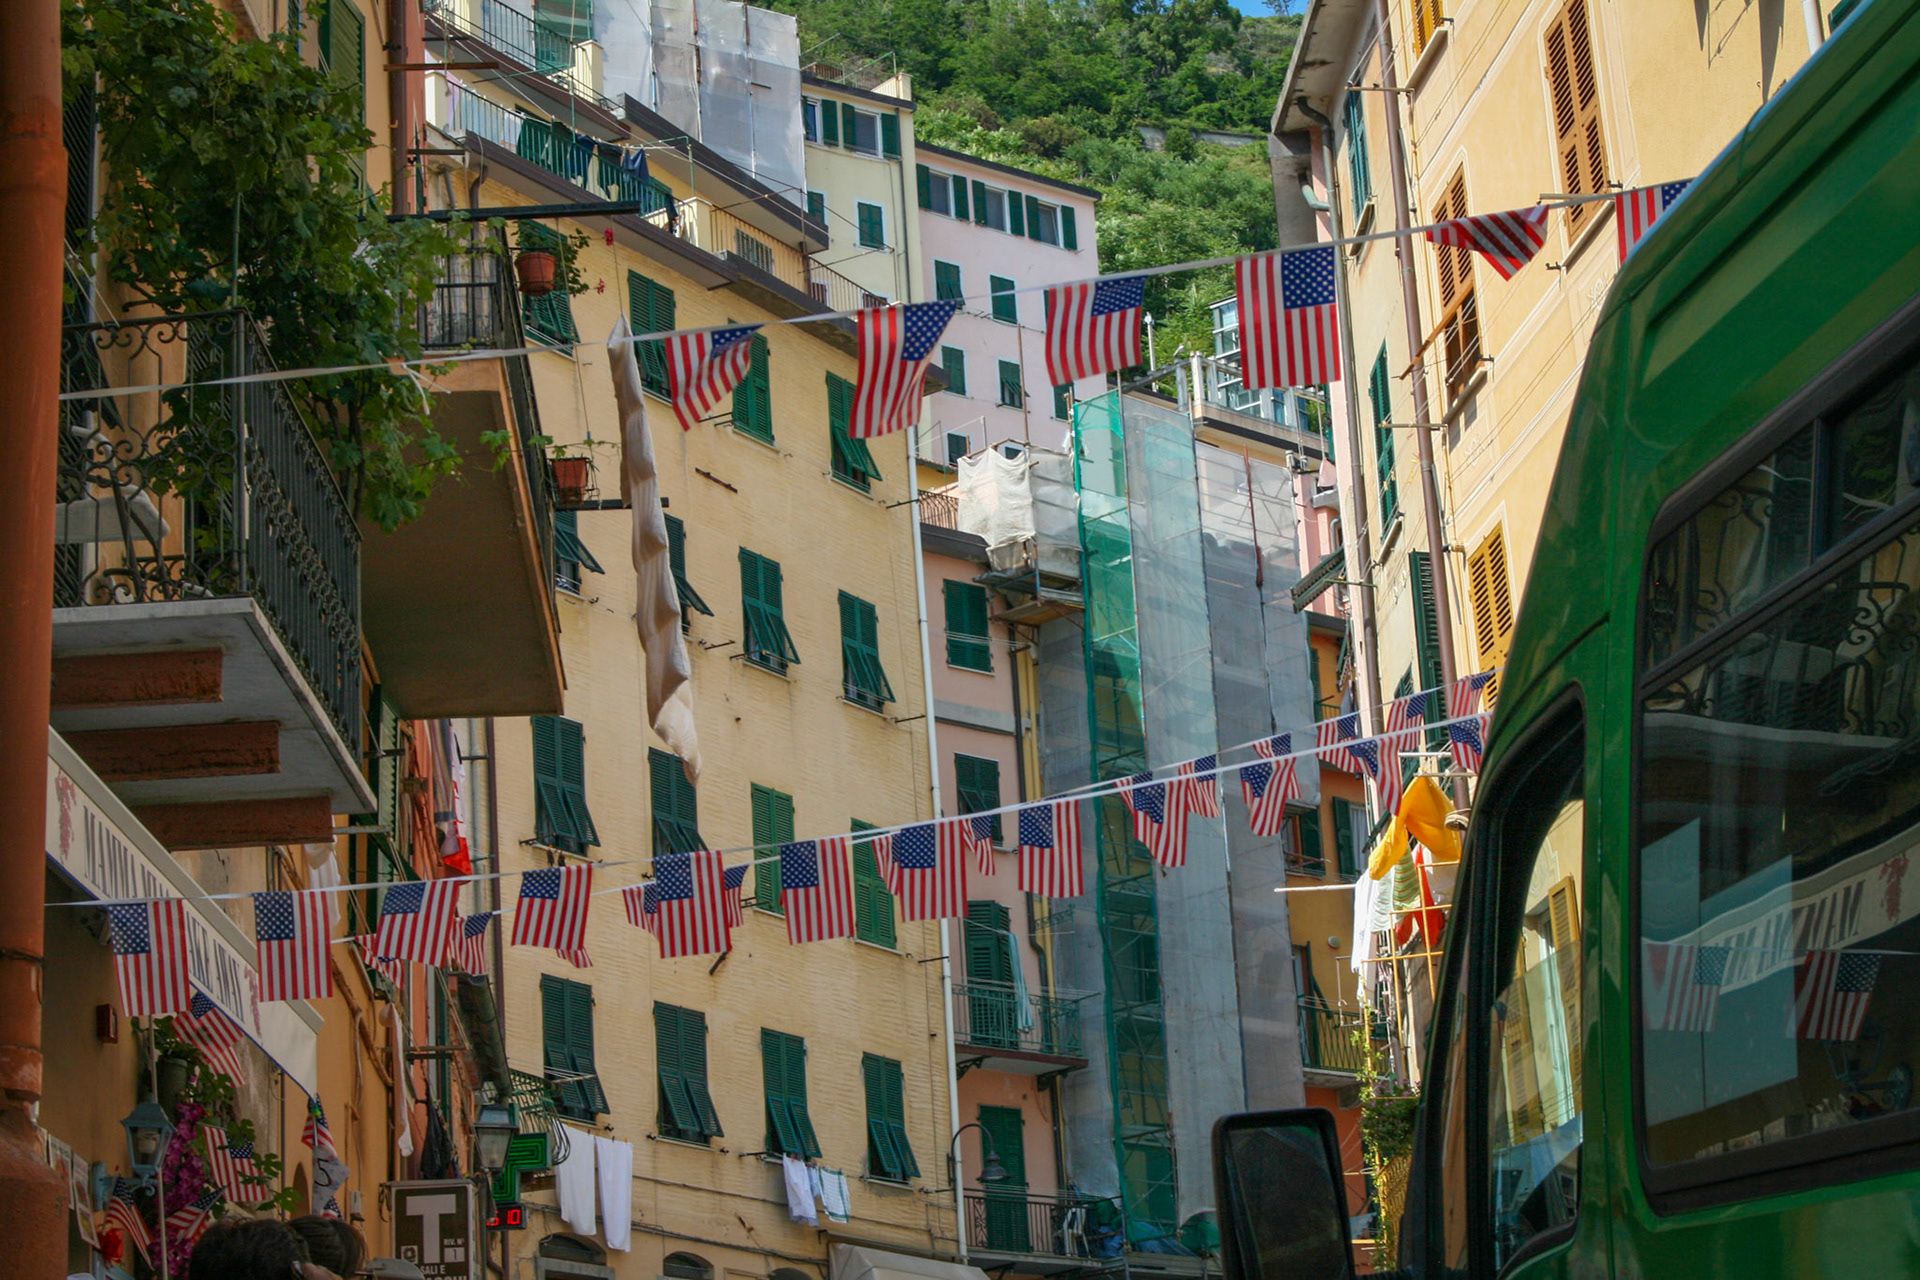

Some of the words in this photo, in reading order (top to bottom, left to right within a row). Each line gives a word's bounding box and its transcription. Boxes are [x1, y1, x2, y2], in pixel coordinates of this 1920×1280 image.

[212, 938, 246, 1024] AWAY
[405, 1193, 457, 1265] T
[420, 1265, 438, 1275] SALI
[440, 1264, 446, 1275] E
